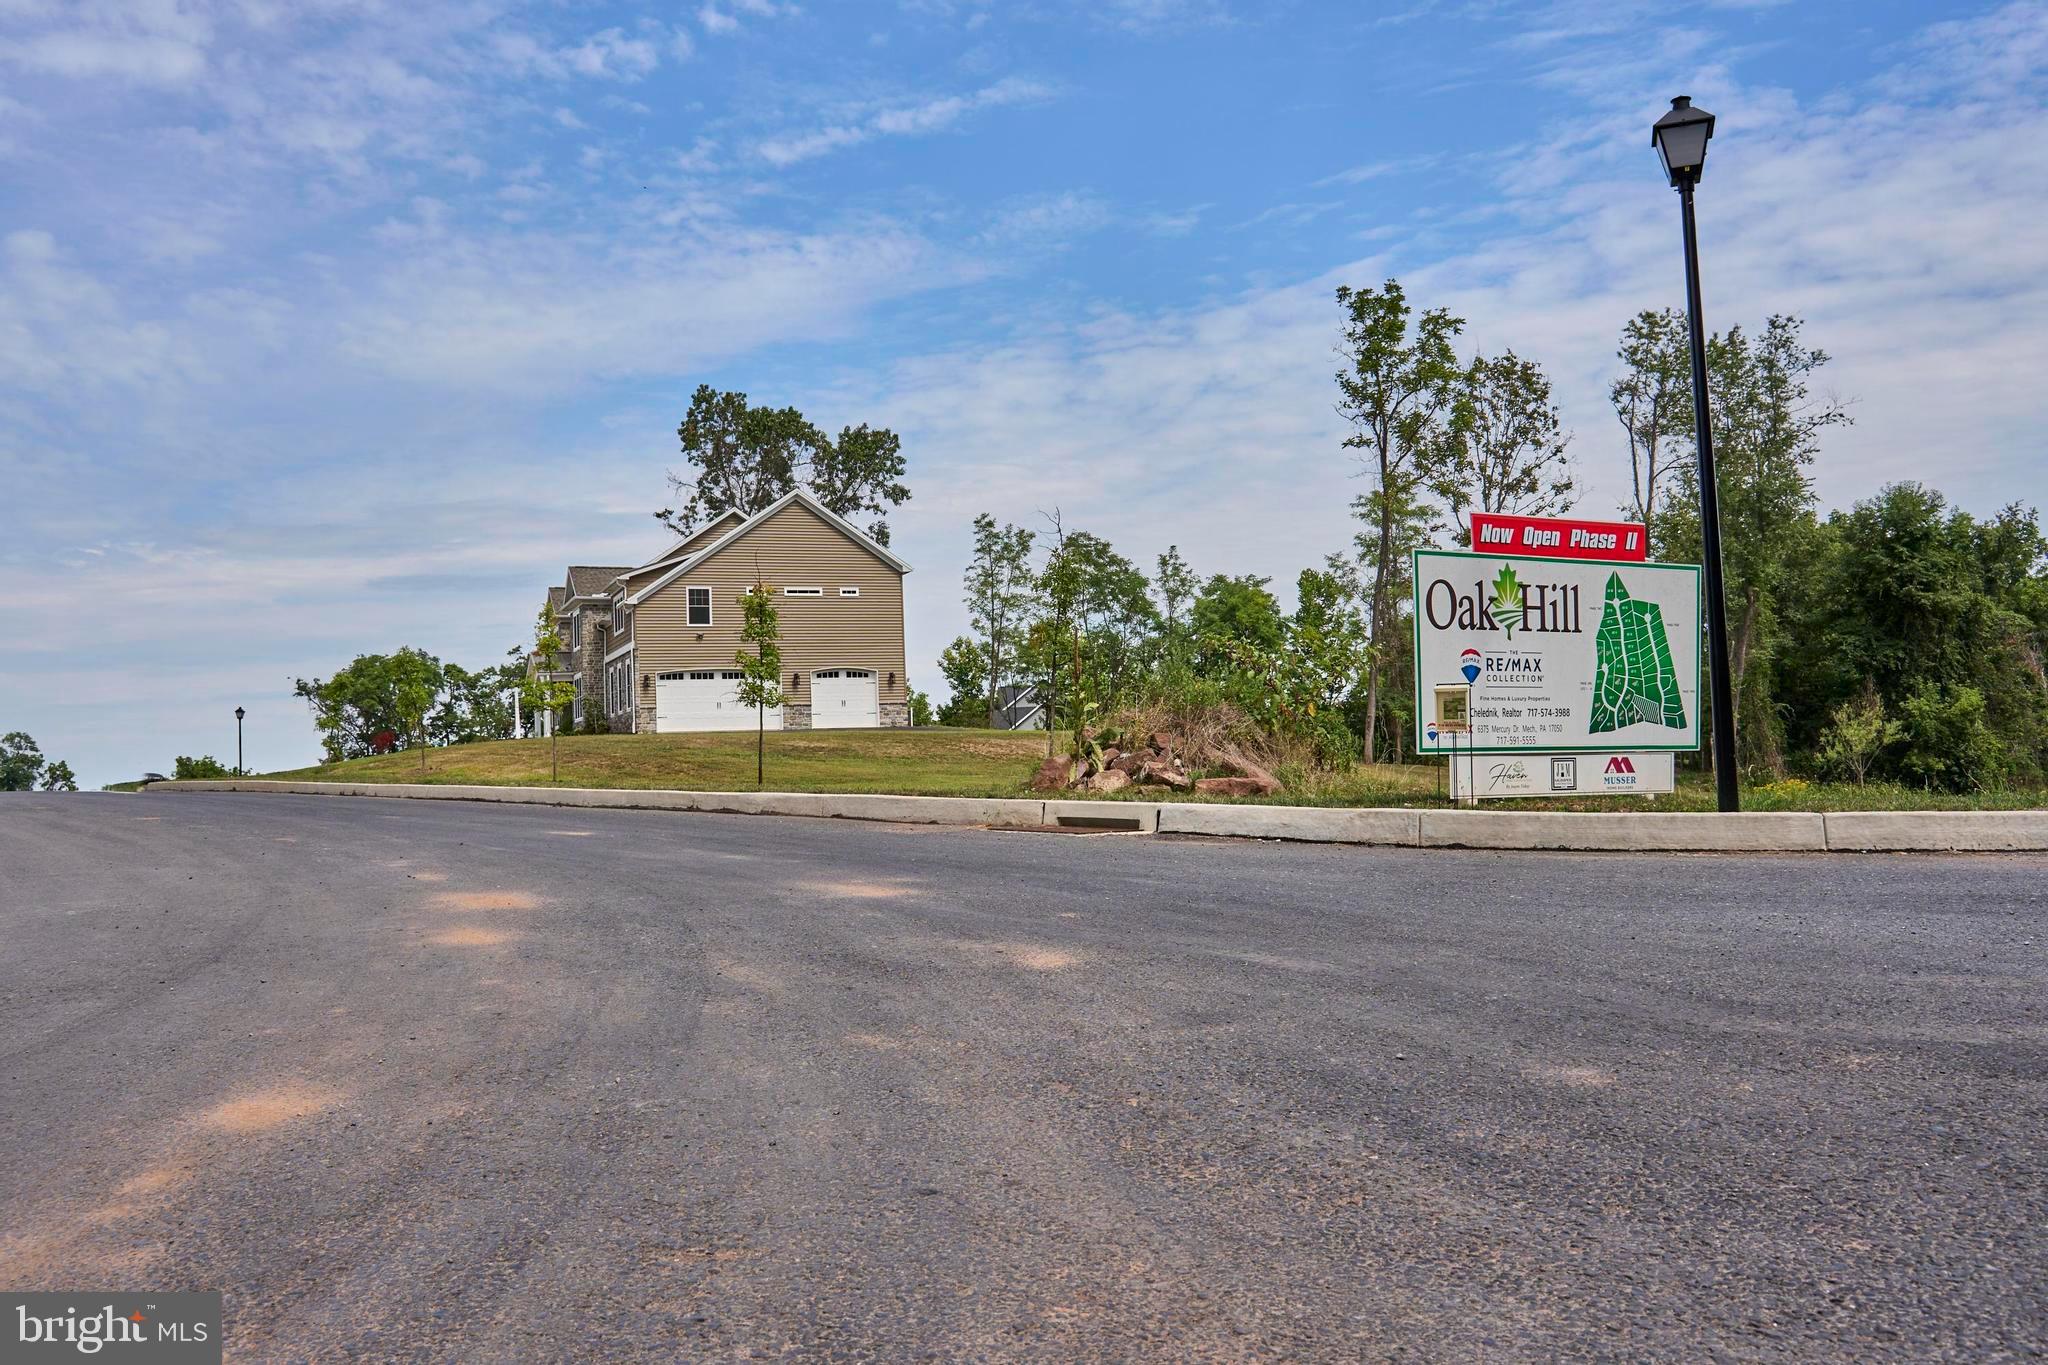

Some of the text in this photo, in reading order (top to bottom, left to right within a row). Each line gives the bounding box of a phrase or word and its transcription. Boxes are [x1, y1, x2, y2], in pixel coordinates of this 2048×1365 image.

[1480, 523, 1514, 543] Now
[1523, 526, 1560, 549] Open
[1570, 529, 1617, 550] Phase
[1426, 578, 1582, 633] Oak Hill
[1486, 658, 1542, 672] RE/MAX
[1486, 674, 1543, 683] COLLECTION
[1502, 707, 1523, 718] Realtor
[1527, 708, 1570, 717] 717-574-3988
[1477, 725, 1489, 733] 6375
[1491, 725, 1511, 735] Mercury
[1539, 725, 1546, 733] PA
[1548, 725, 1563, 733] 17050
[1496, 736, 1537, 744] 717-591-5555
[1604, 776, 1636, 784] MUSSER
